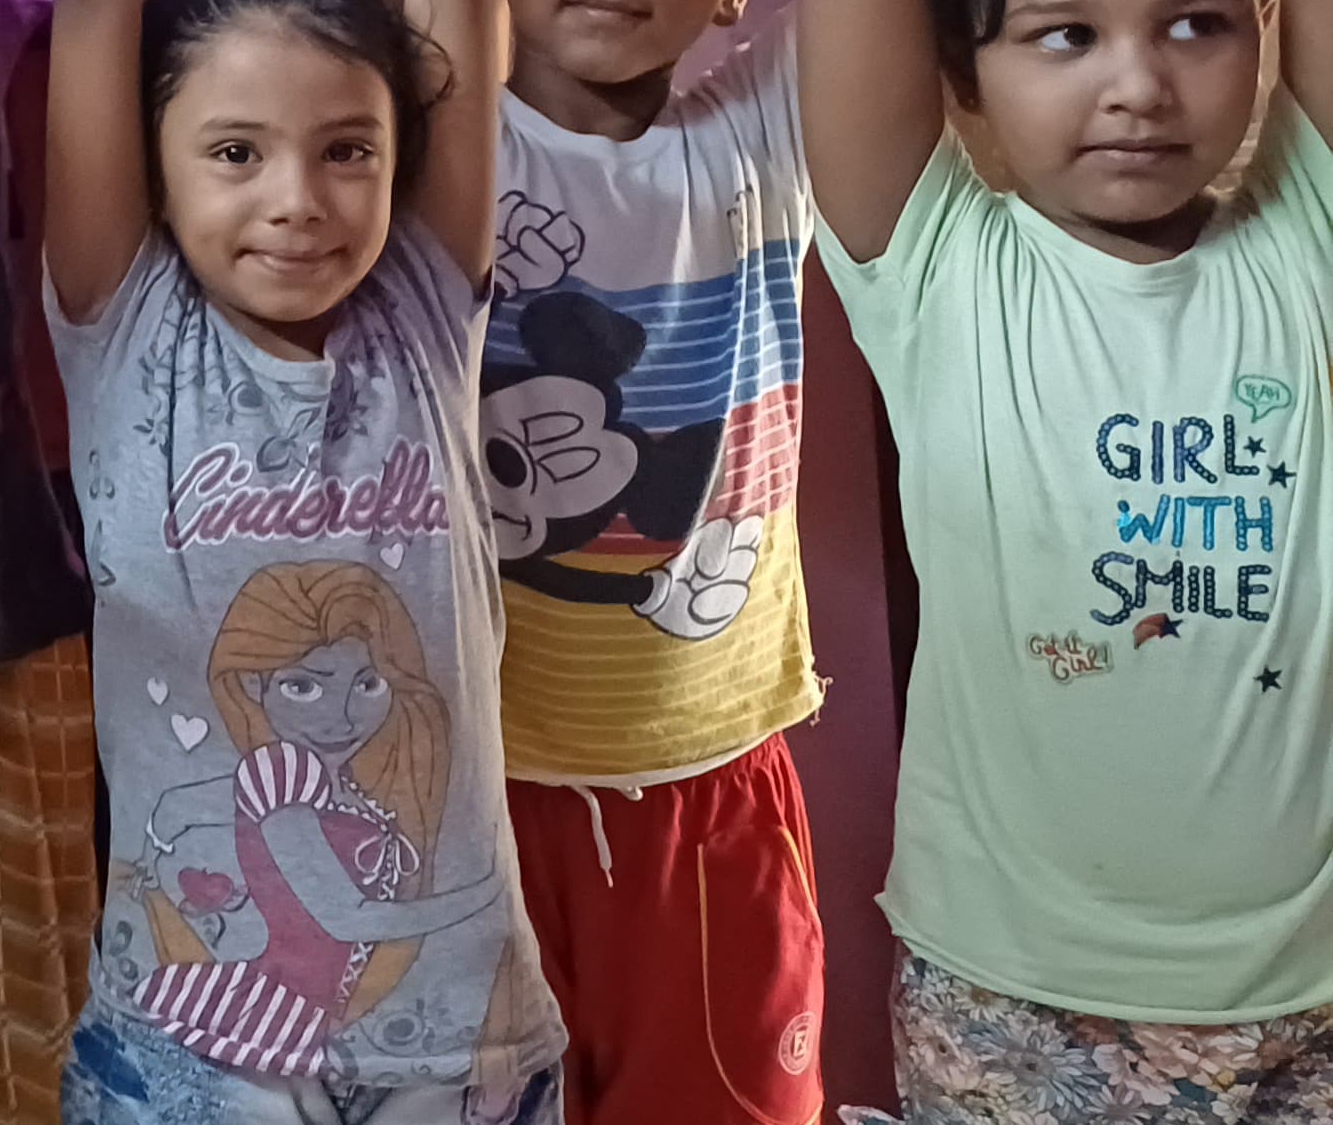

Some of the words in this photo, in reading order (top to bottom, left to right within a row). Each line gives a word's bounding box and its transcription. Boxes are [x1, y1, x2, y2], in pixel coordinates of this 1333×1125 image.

[1243, 382, 1282, 403] YEAH
[1096, 413, 1260, 484] GIRL
[163, 438, 451, 552] Cinderella
[1117, 494, 1274, 552] WITH
[1090, 551, 1272, 625] SMILE
